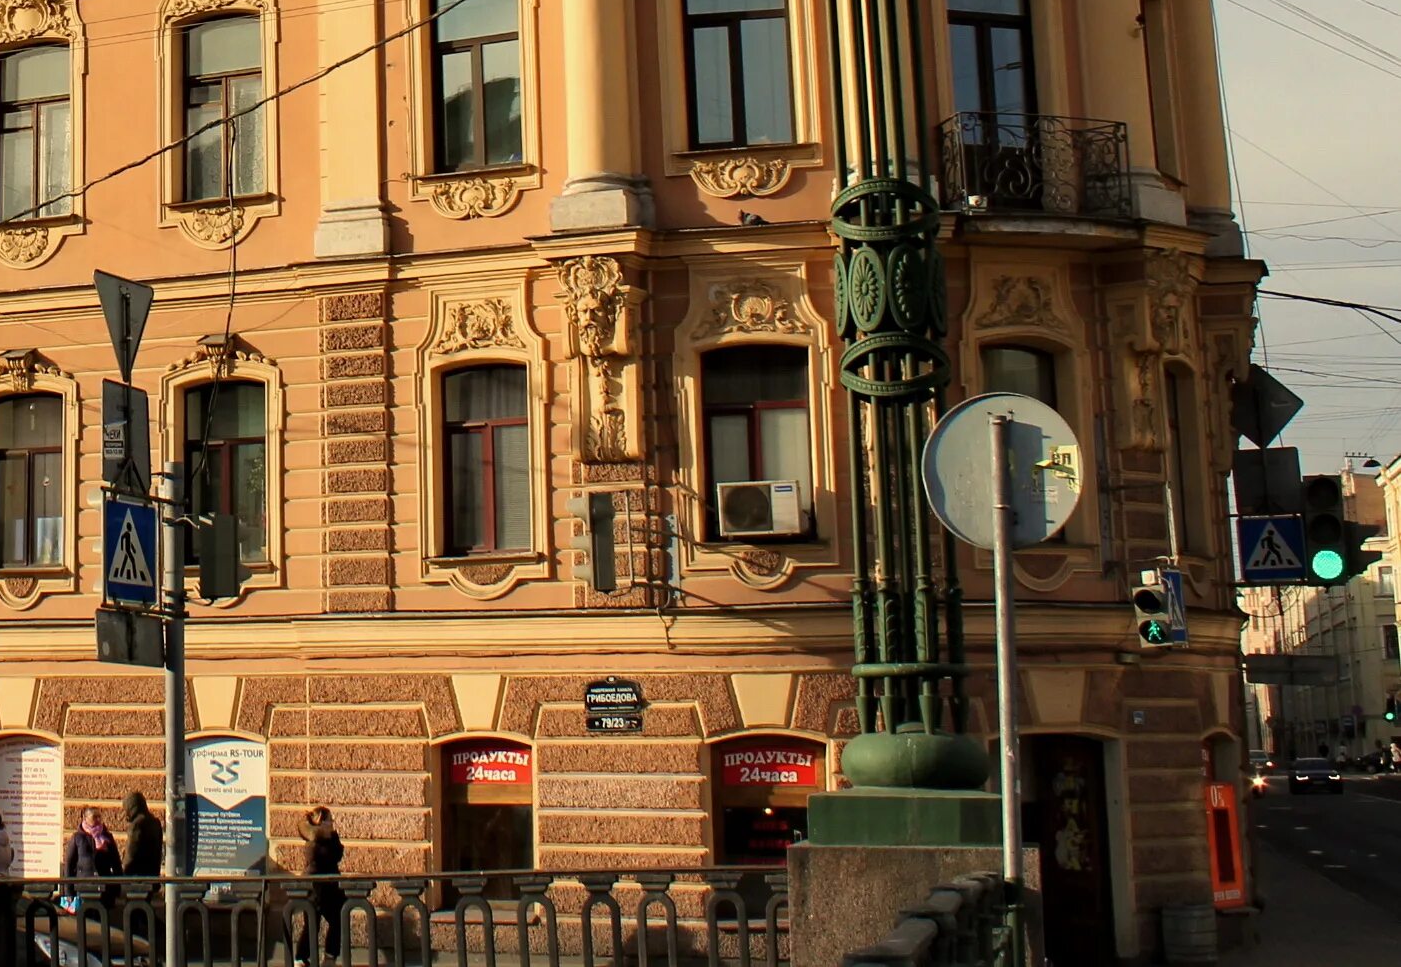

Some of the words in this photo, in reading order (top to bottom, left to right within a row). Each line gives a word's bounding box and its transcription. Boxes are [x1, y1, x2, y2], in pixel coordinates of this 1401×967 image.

[586, 693, 638, 703] ГРИБОЕДОВА
[601, 717, 624, 728] 79/23
[188, 748, 228, 759] Турфирма
[229, 748, 265, 759] RS-TOUR
[453, 750, 529, 766] ПРОДУКТЫ
[724, 751, 813, 767] ПРОДУКТЫ
[466, 766, 517, 782] 24часа
[740, 767, 798, 783] 24часа
